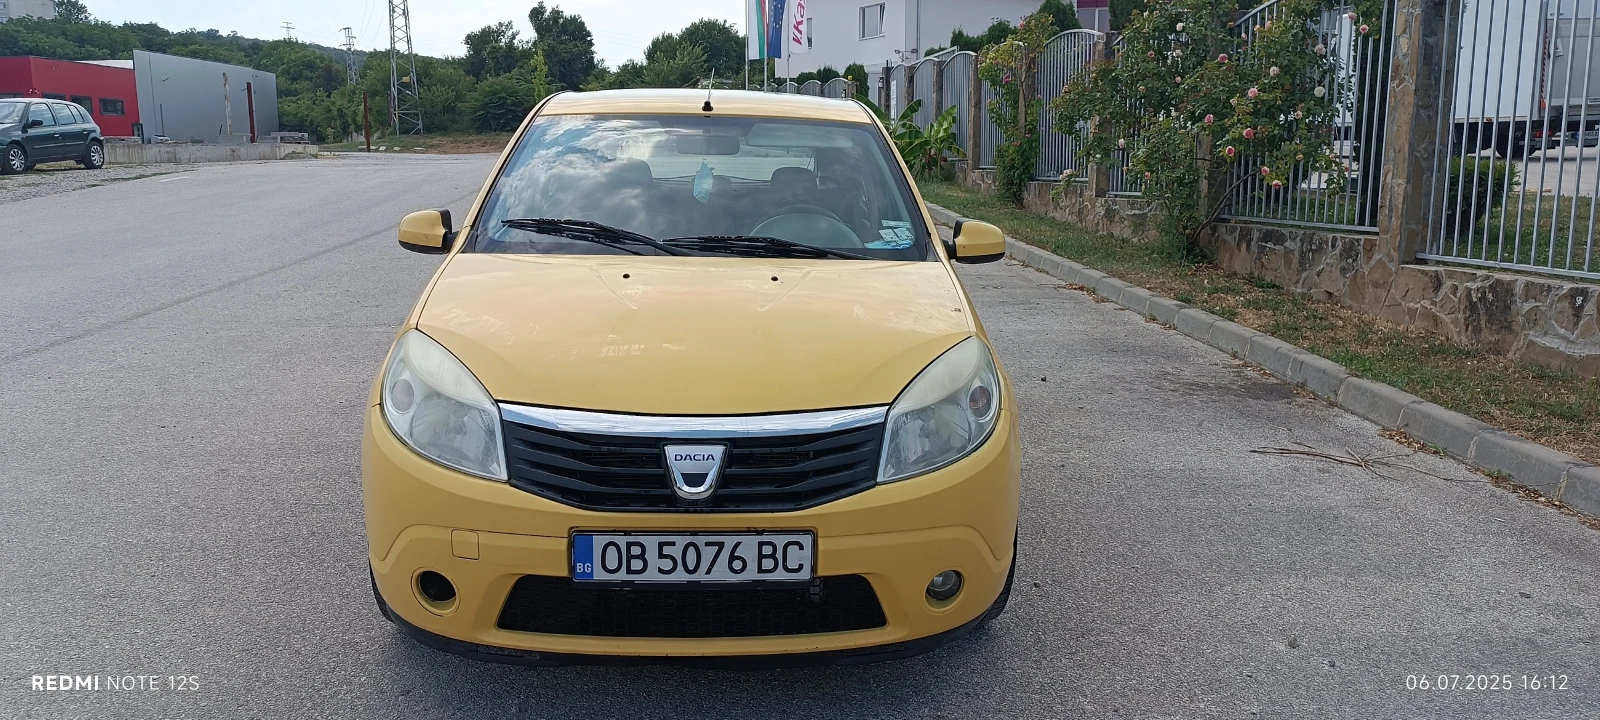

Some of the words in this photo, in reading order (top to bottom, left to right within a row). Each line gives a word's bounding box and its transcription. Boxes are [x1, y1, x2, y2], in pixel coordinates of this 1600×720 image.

[792, 0, 805, 46] V.Ka
[674, 453, 716, 462] DACIA
[576, 562, 592, 573] BG
[600, 540, 648, 576] OB
[657, 540, 748, 576] 5076
[757, 540, 805, 575] BC
